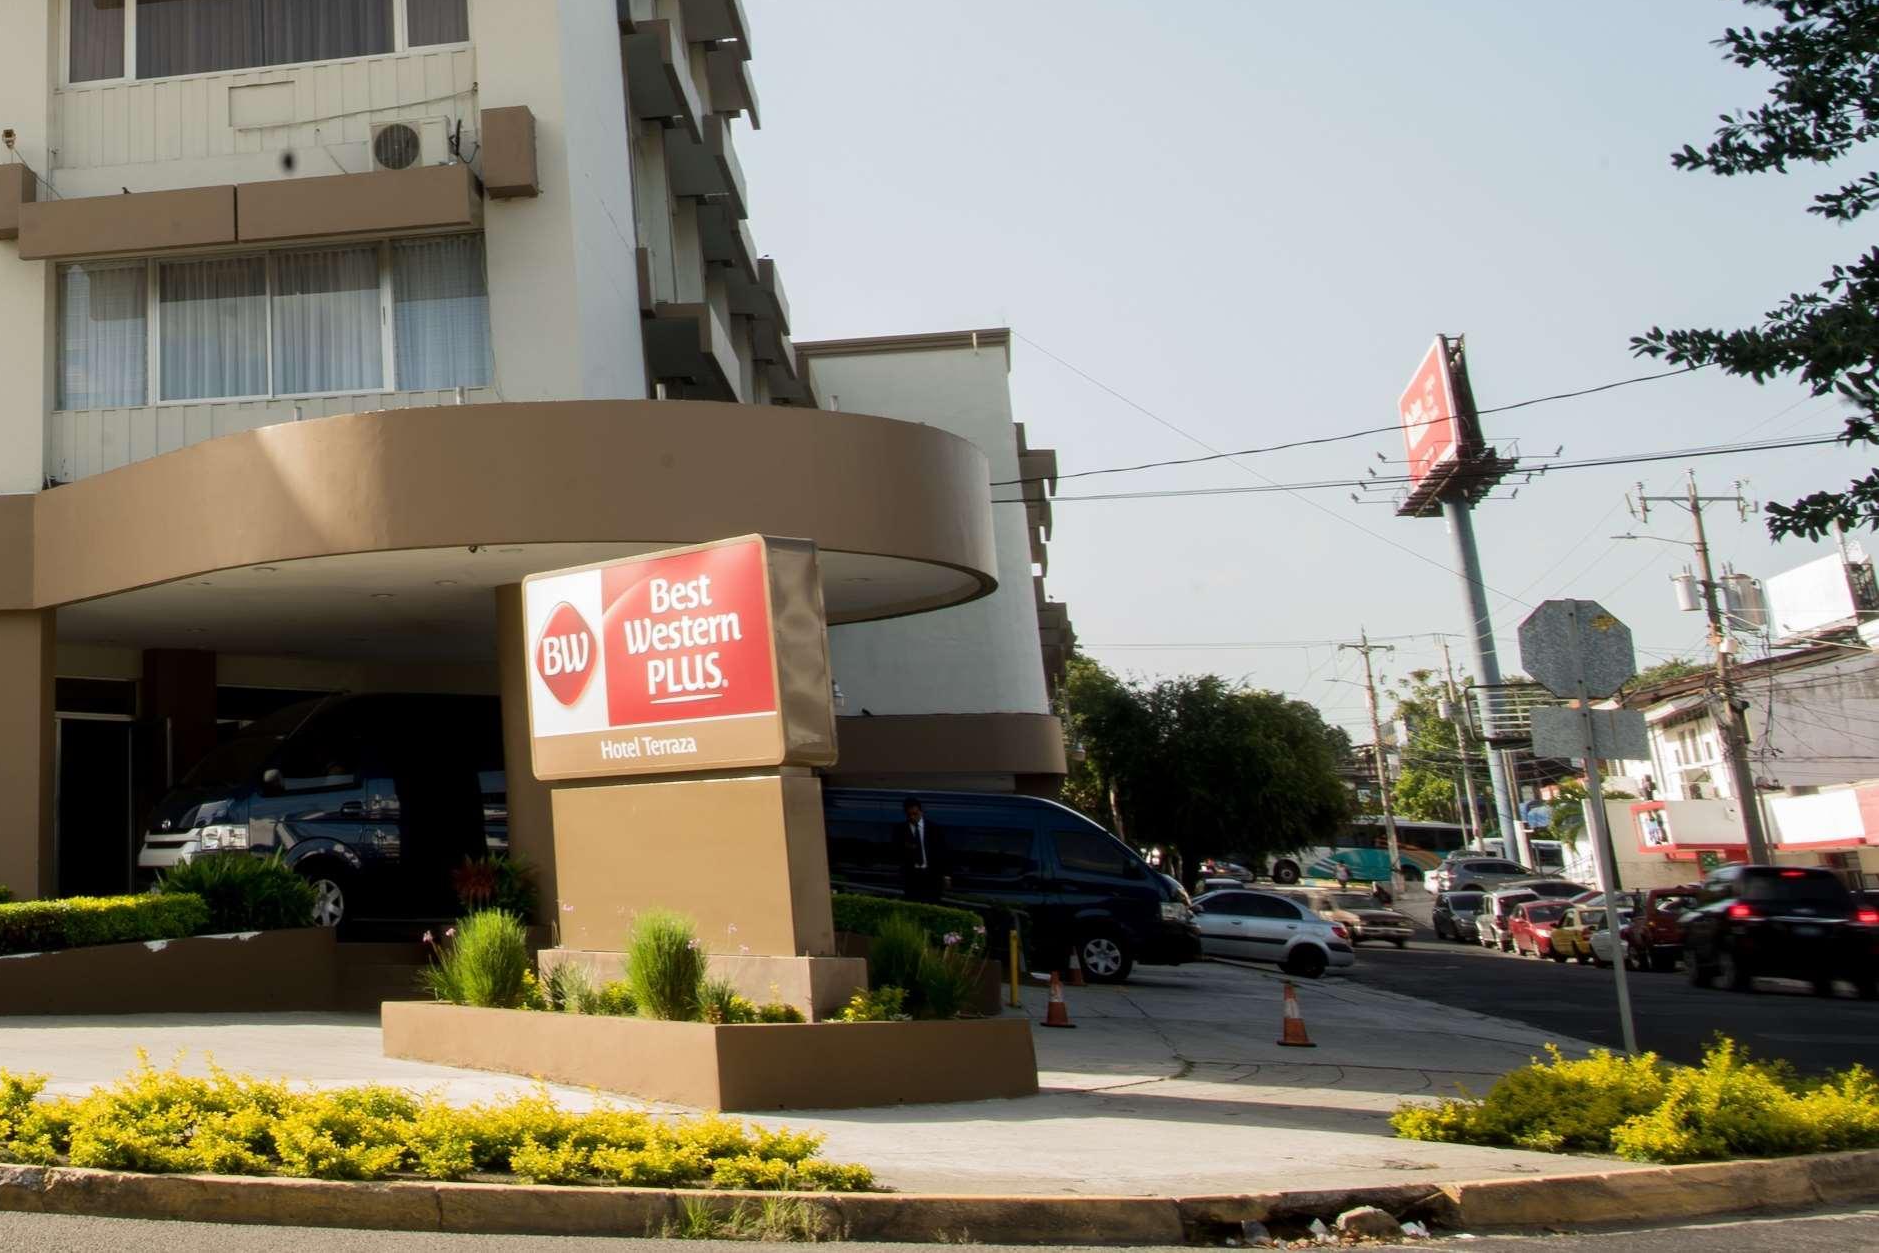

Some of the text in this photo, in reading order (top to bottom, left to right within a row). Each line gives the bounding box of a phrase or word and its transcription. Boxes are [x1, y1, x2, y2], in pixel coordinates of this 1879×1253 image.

[649, 574, 712, 614] Best
[542, 631, 589, 676] BW
[623, 612, 742, 655] Western
[647, 651, 724, 695] PLUS
[600, 735, 698, 760] Hotel Terraza
